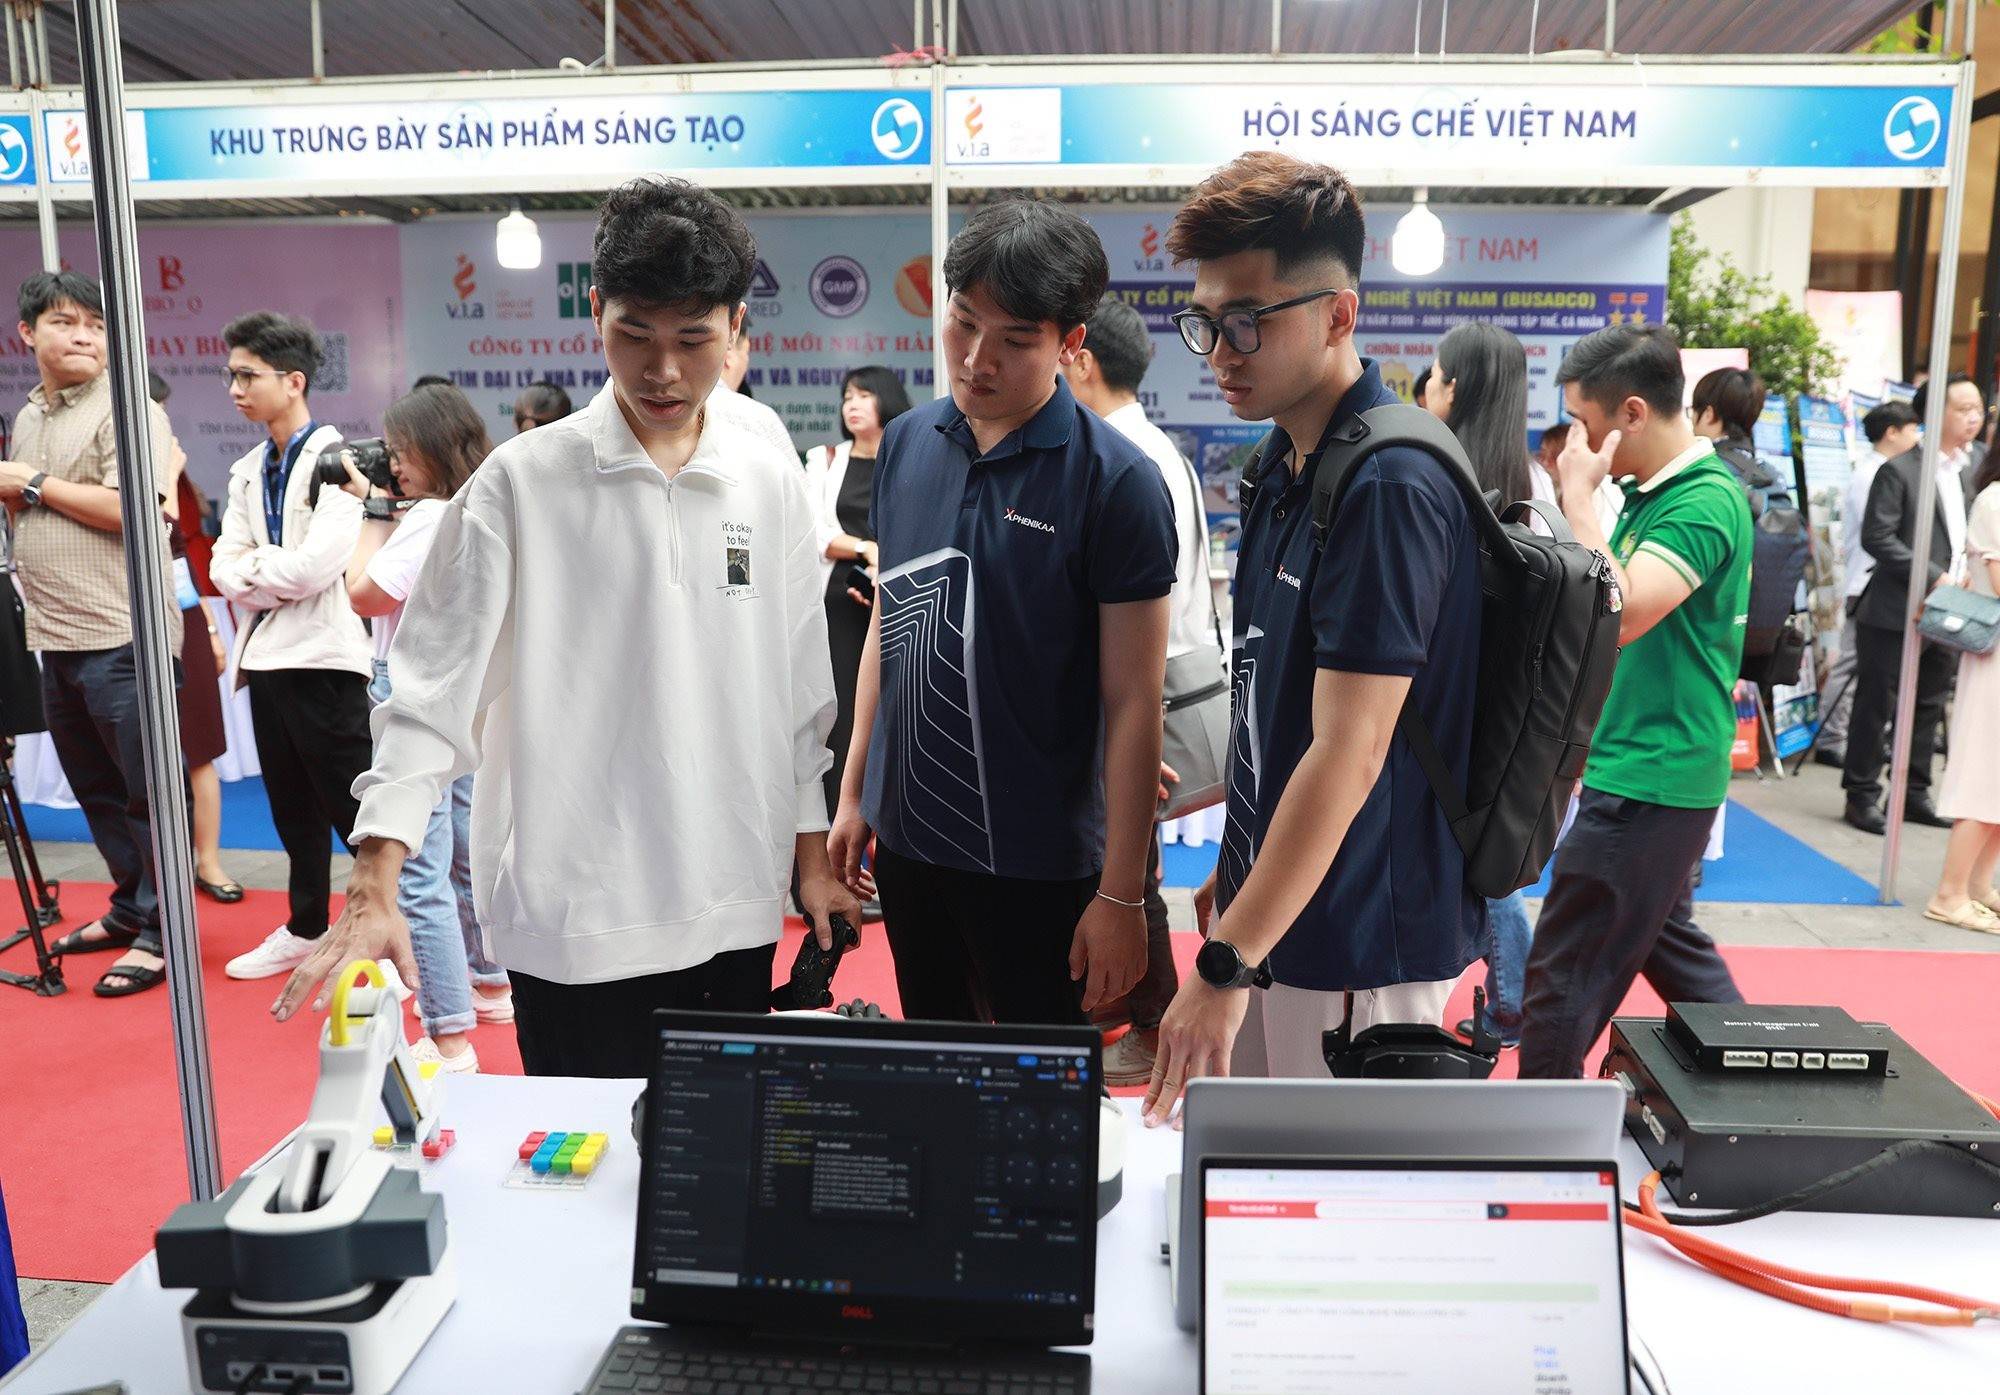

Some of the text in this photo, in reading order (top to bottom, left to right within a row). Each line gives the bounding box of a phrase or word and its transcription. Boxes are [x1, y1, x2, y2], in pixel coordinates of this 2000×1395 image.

[1244, 96, 1636, 146] HỘI SÁNG CHẾ VIỆT NAM
[210, 107, 744, 155] KHU TRƯNG BÀY SẢN PHẨM SÁNG TẠO
[1479, 238, 1538, 261] NAM
[822, 280, 856, 294] GMP
[1456, 291, 1498, 308] NAM
[468, 336, 523, 355] CÔNG
[529, 337, 553, 354] TY
[560, 330, 586, 354] CỔ
[721, 520, 735, 532] it's
[1011, 514, 1056, 533] PHENIKAA
[727, 536, 736, 545] to
